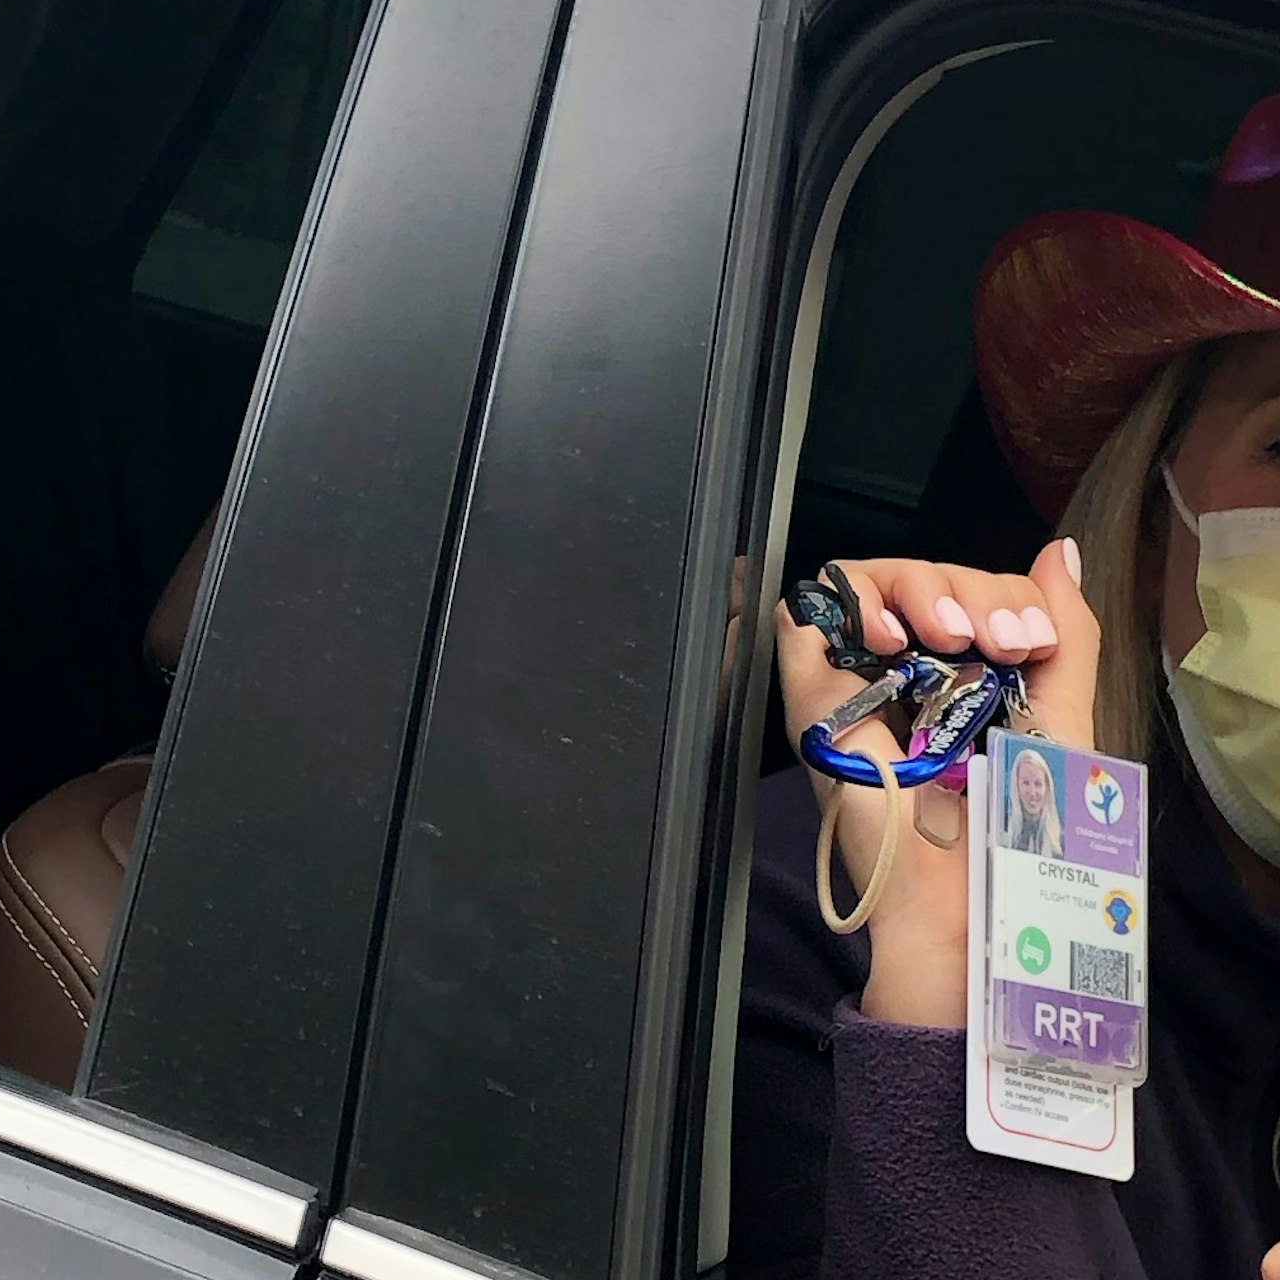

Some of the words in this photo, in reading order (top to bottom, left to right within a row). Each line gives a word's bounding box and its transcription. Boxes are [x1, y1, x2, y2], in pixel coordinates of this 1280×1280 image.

[1038, 861, 1100, 888] CRYSTAL
[1039, 889, 1071, 905] FLIGHT
[1072, 894, 1097, 910] TEAM
[1034, 1001, 1104, 1048] RRT
